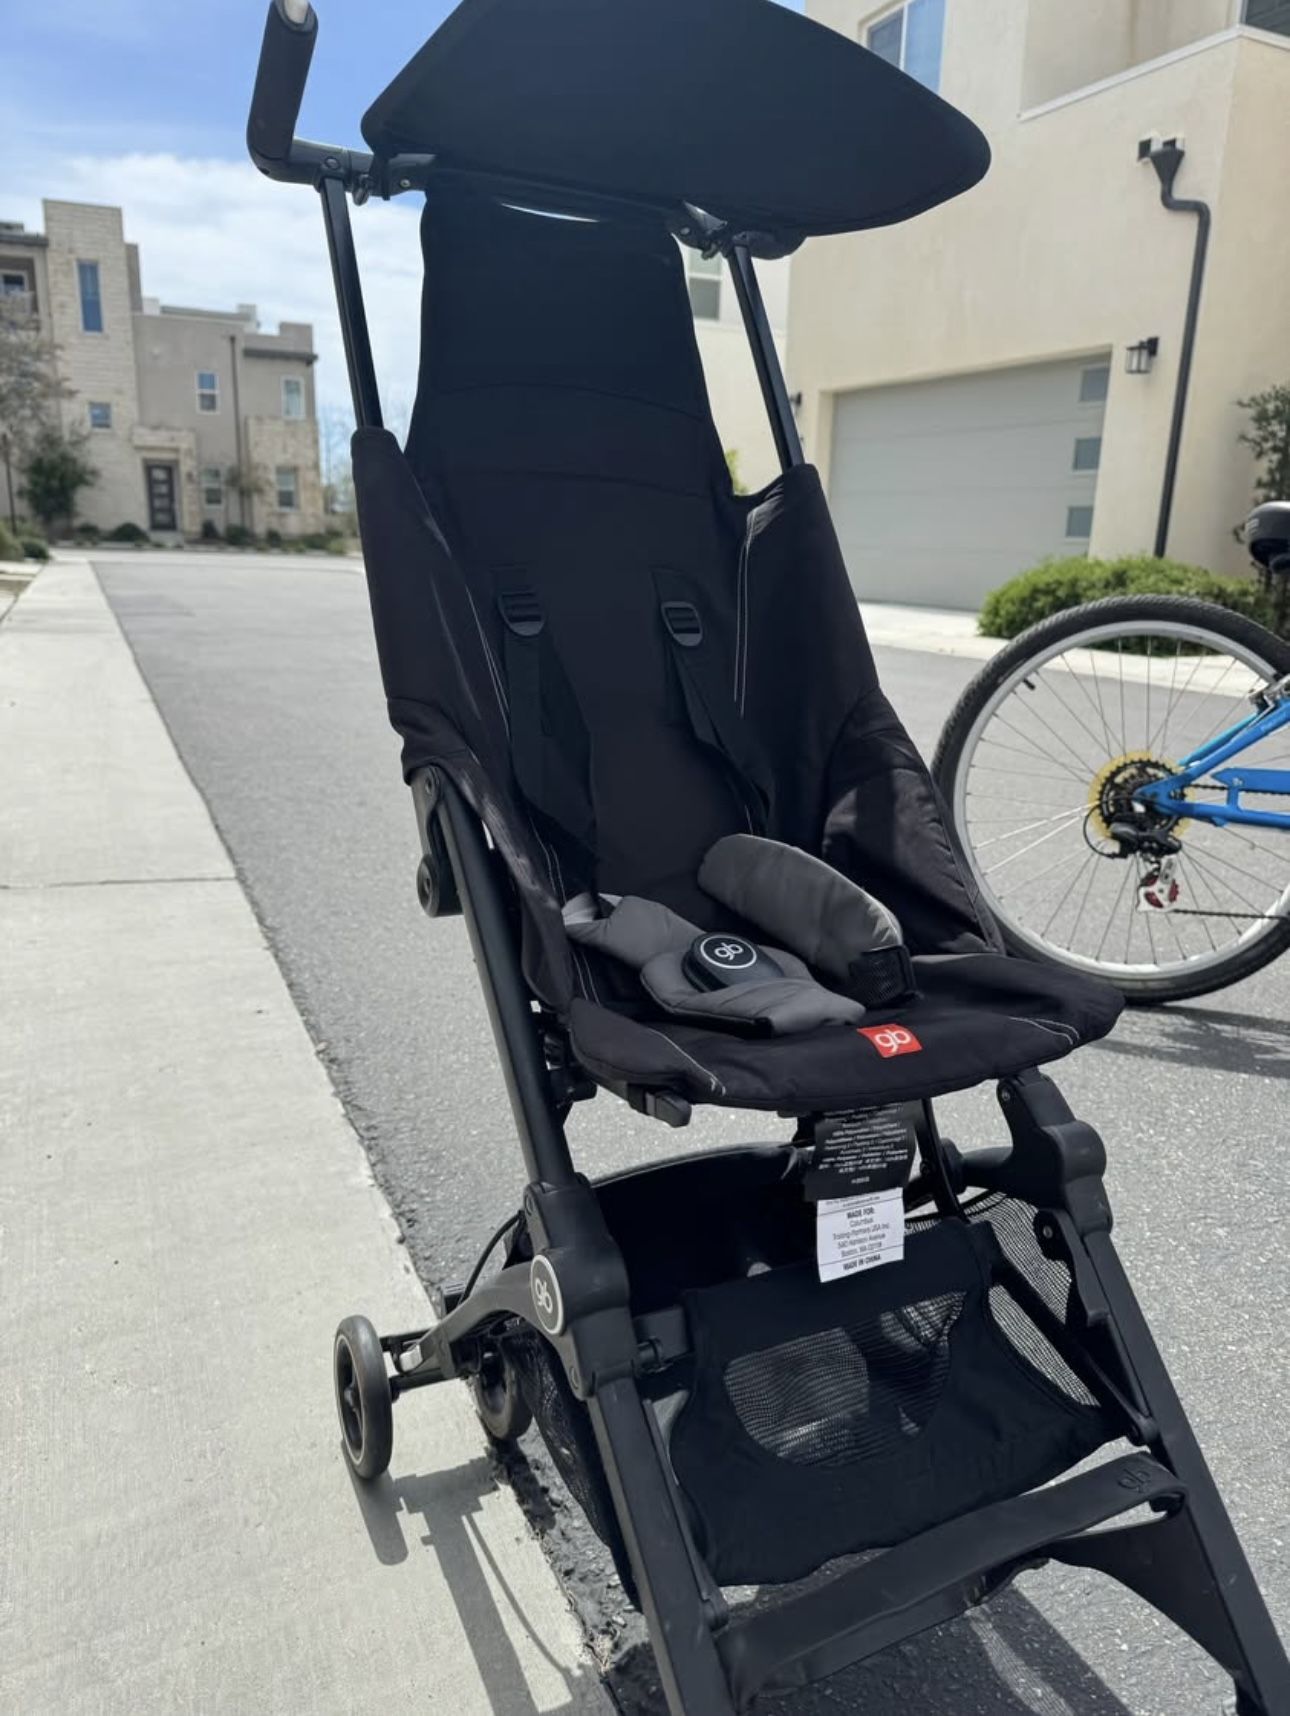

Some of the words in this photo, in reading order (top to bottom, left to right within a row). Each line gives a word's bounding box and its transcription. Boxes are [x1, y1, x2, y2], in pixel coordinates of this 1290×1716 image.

[714, 942, 743, 960] gb
[874, 1028, 911, 1053] gb
[847, 1208, 861, 1219] MADE
[843, 1259, 858, 1270] MADE
[865, 1253, 881, 1264] CHINA
[535, 1278, 553, 1314] gb
